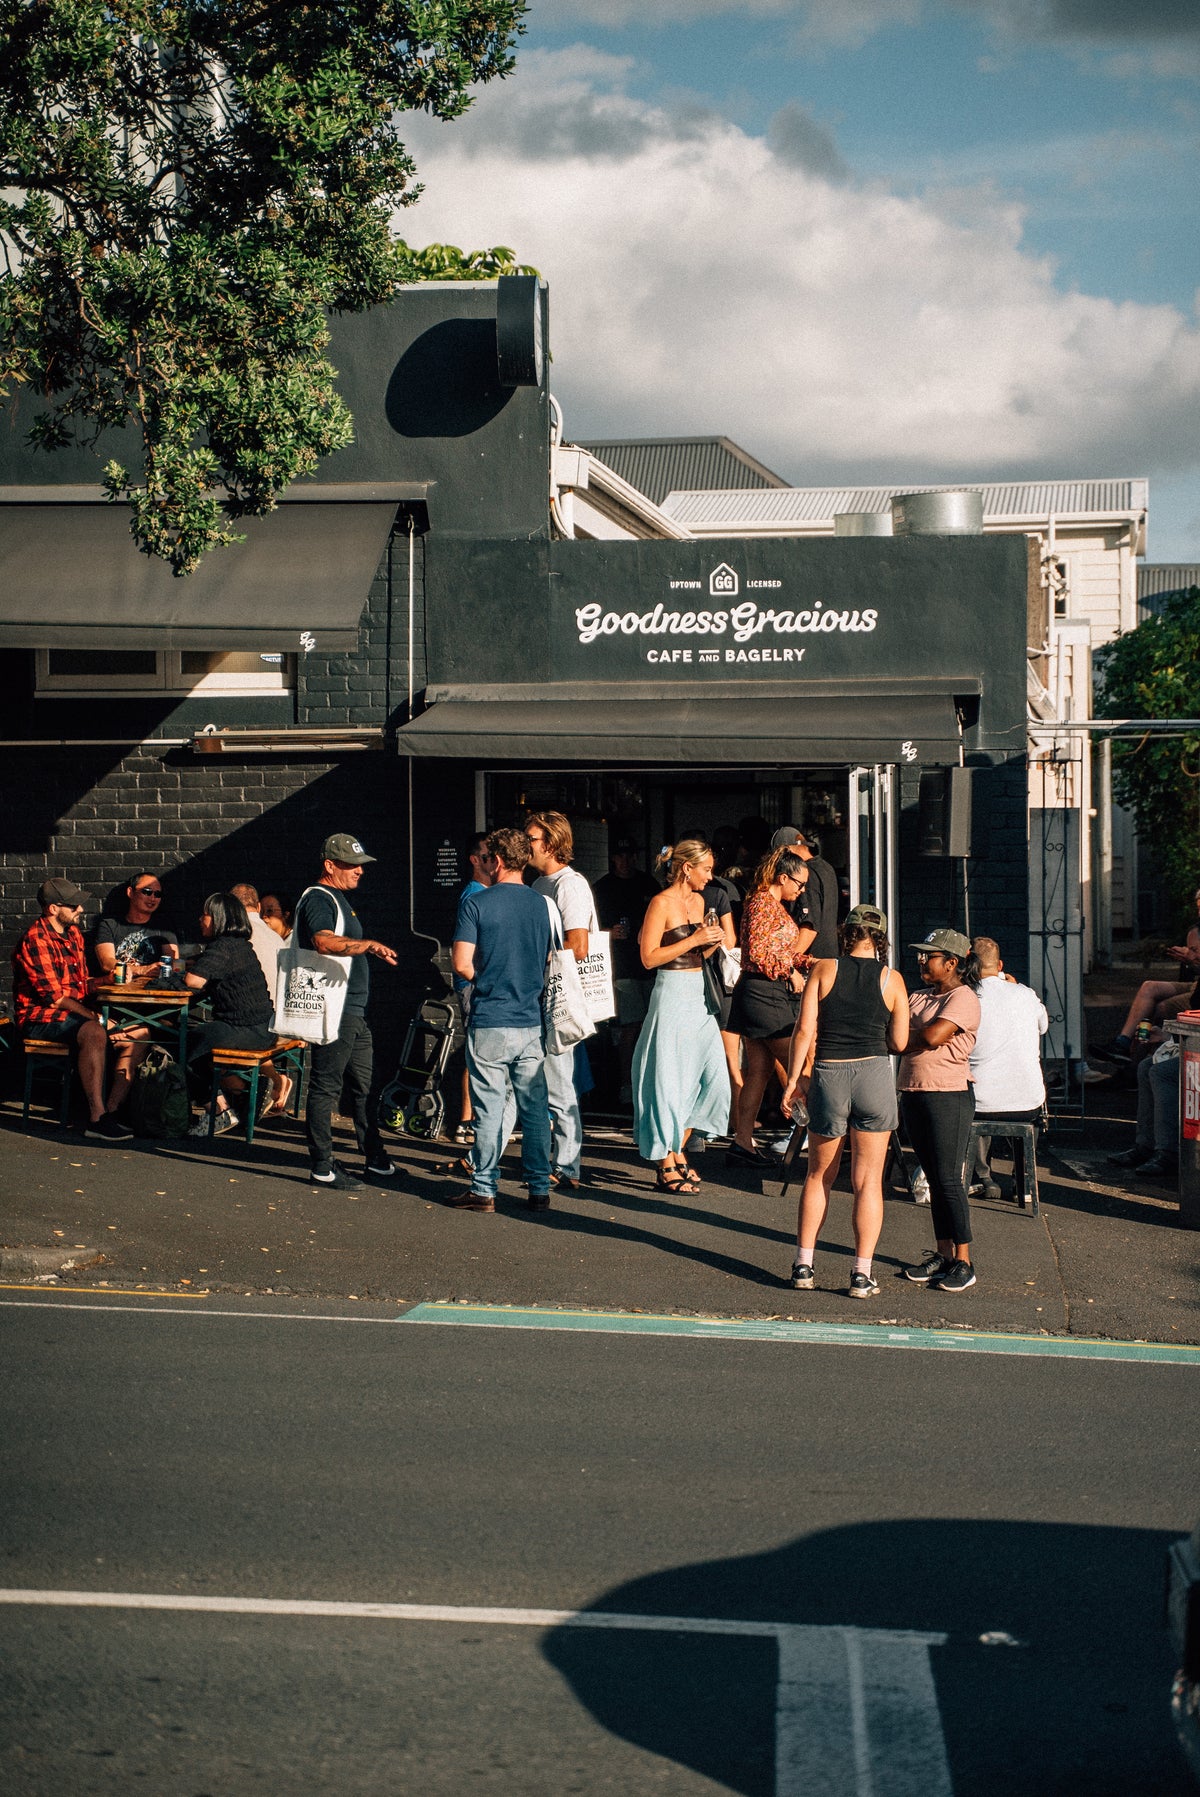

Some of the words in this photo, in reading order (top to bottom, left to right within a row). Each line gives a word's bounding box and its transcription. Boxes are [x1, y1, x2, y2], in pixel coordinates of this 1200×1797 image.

[670, 580, 702, 589] UPTOWN
[715, 575, 733, 590] GG
[746, 580, 782, 588] LICENSED
[575, 602, 730, 644] Goodness
[730, 600, 878, 643] Gracious
[646, 649, 693, 664] CAFE
[698, 652, 720, 663] AND
[725, 648, 806, 662] BAGELRY
[284, 989, 325, 1002] Goodness
[284, 998, 322, 1010] Gracious
